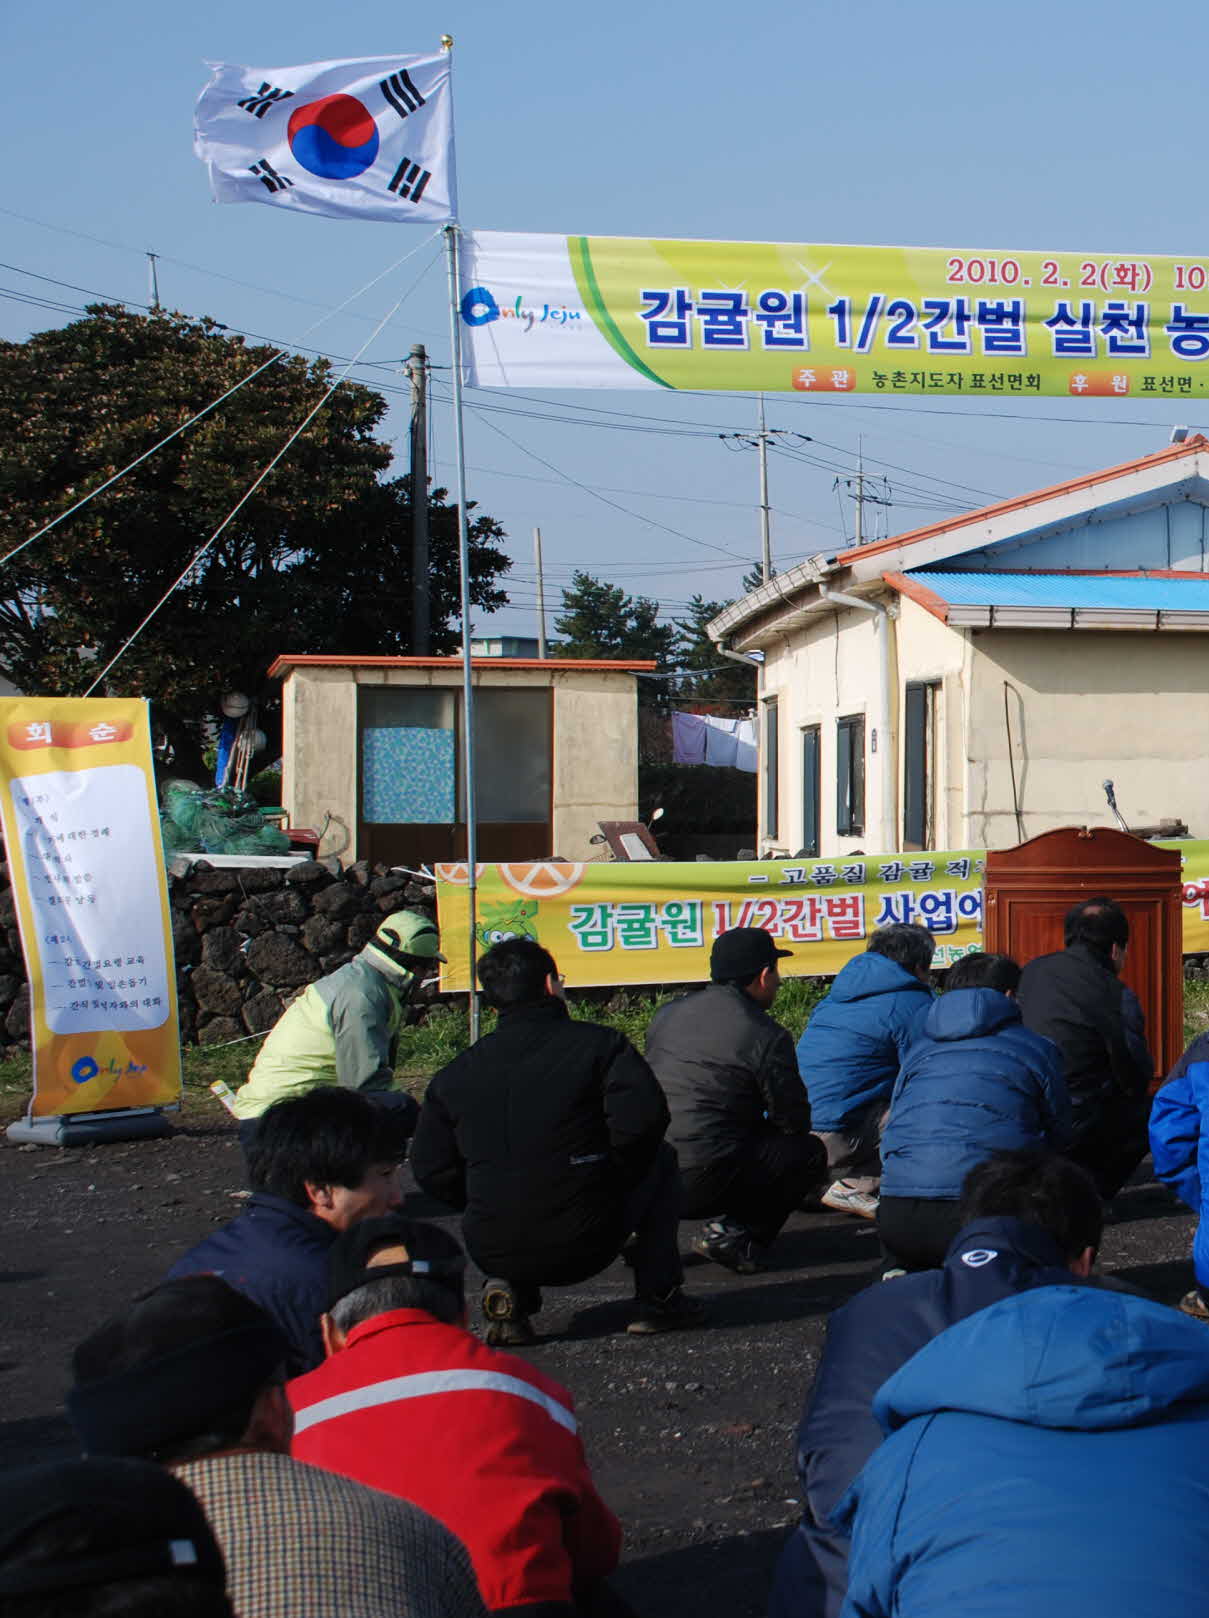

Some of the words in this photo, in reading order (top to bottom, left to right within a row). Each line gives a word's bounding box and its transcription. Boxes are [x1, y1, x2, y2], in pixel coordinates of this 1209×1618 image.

[948, 258, 1031, 286] 2010.
[1081, 262, 1152, 292] 2(화)
[540, 304, 580, 325] Jeju
[639, 288, 805, 347] 감귤원
[828, 296, 1023, 352] 1/2간벌
[1045, 302, 1149, 355] 실천
[871, 371, 963, 389] 농촌지도자
[969, 372, 1041, 390] 표선면회
[1141, 375, 1193, 393] 표선면
[782, 864, 864, 886] 고품질
[881, 860, 934, 882] 감귤
[572, 901, 699, 947] 감귤원
[714, 895, 862, 938] 1/2간벌
